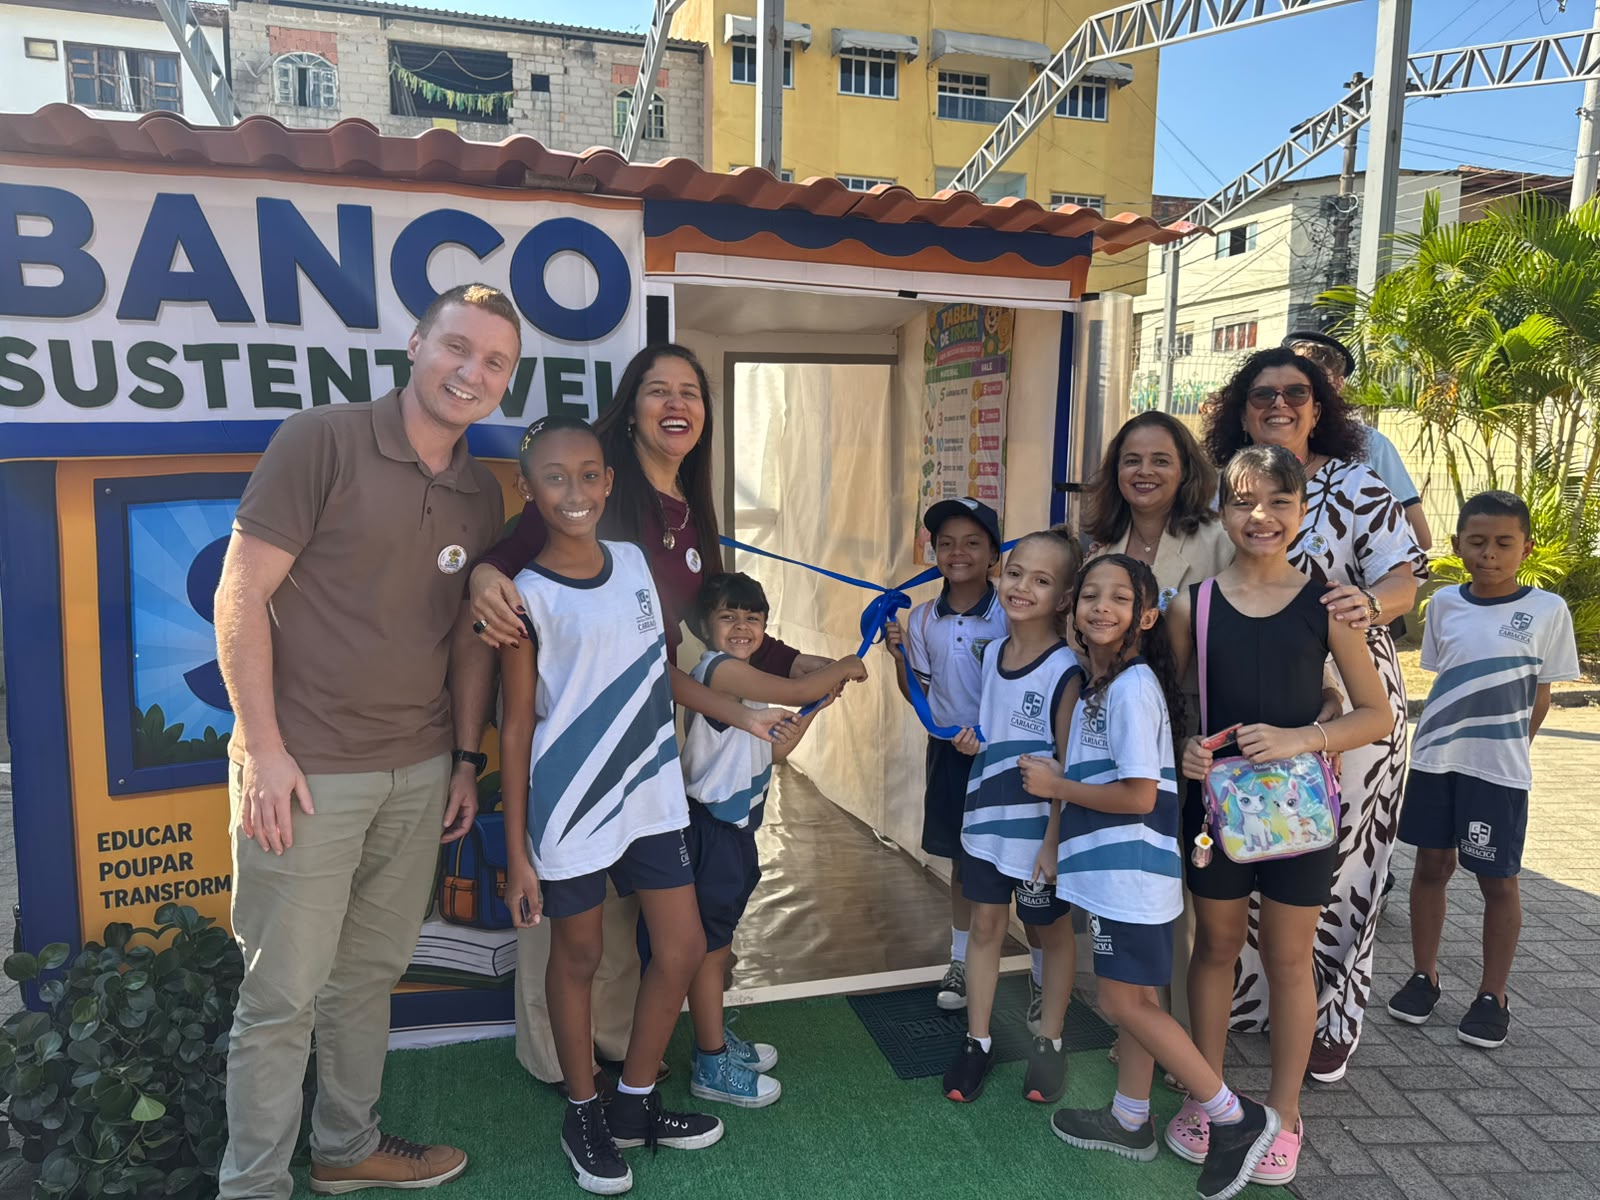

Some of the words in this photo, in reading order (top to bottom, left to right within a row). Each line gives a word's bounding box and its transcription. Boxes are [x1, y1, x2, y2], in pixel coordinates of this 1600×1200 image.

[0, 183, 631, 341] BANCO
[942, 303, 979, 329] TABELA
[940, 330, 949, 348] DE
[950, 320, 978, 341] TROCA
[981, 362, 993, 372] VALE
[939, 387, 946, 402] 5
[938, 411, 943, 427] 3
[937, 461, 942, 476] 2
[1011, 716, 1045, 733] CARIACICA
[97, 823, 193, 853] EDUCAR
[1461, 844, 1495, 859] CARIACICA
[99, 852, 194, 882] POUPAR
[100, 875, 232, 909] TRANSFORM
[1016, 892, 1050, 905] CARIACICA
